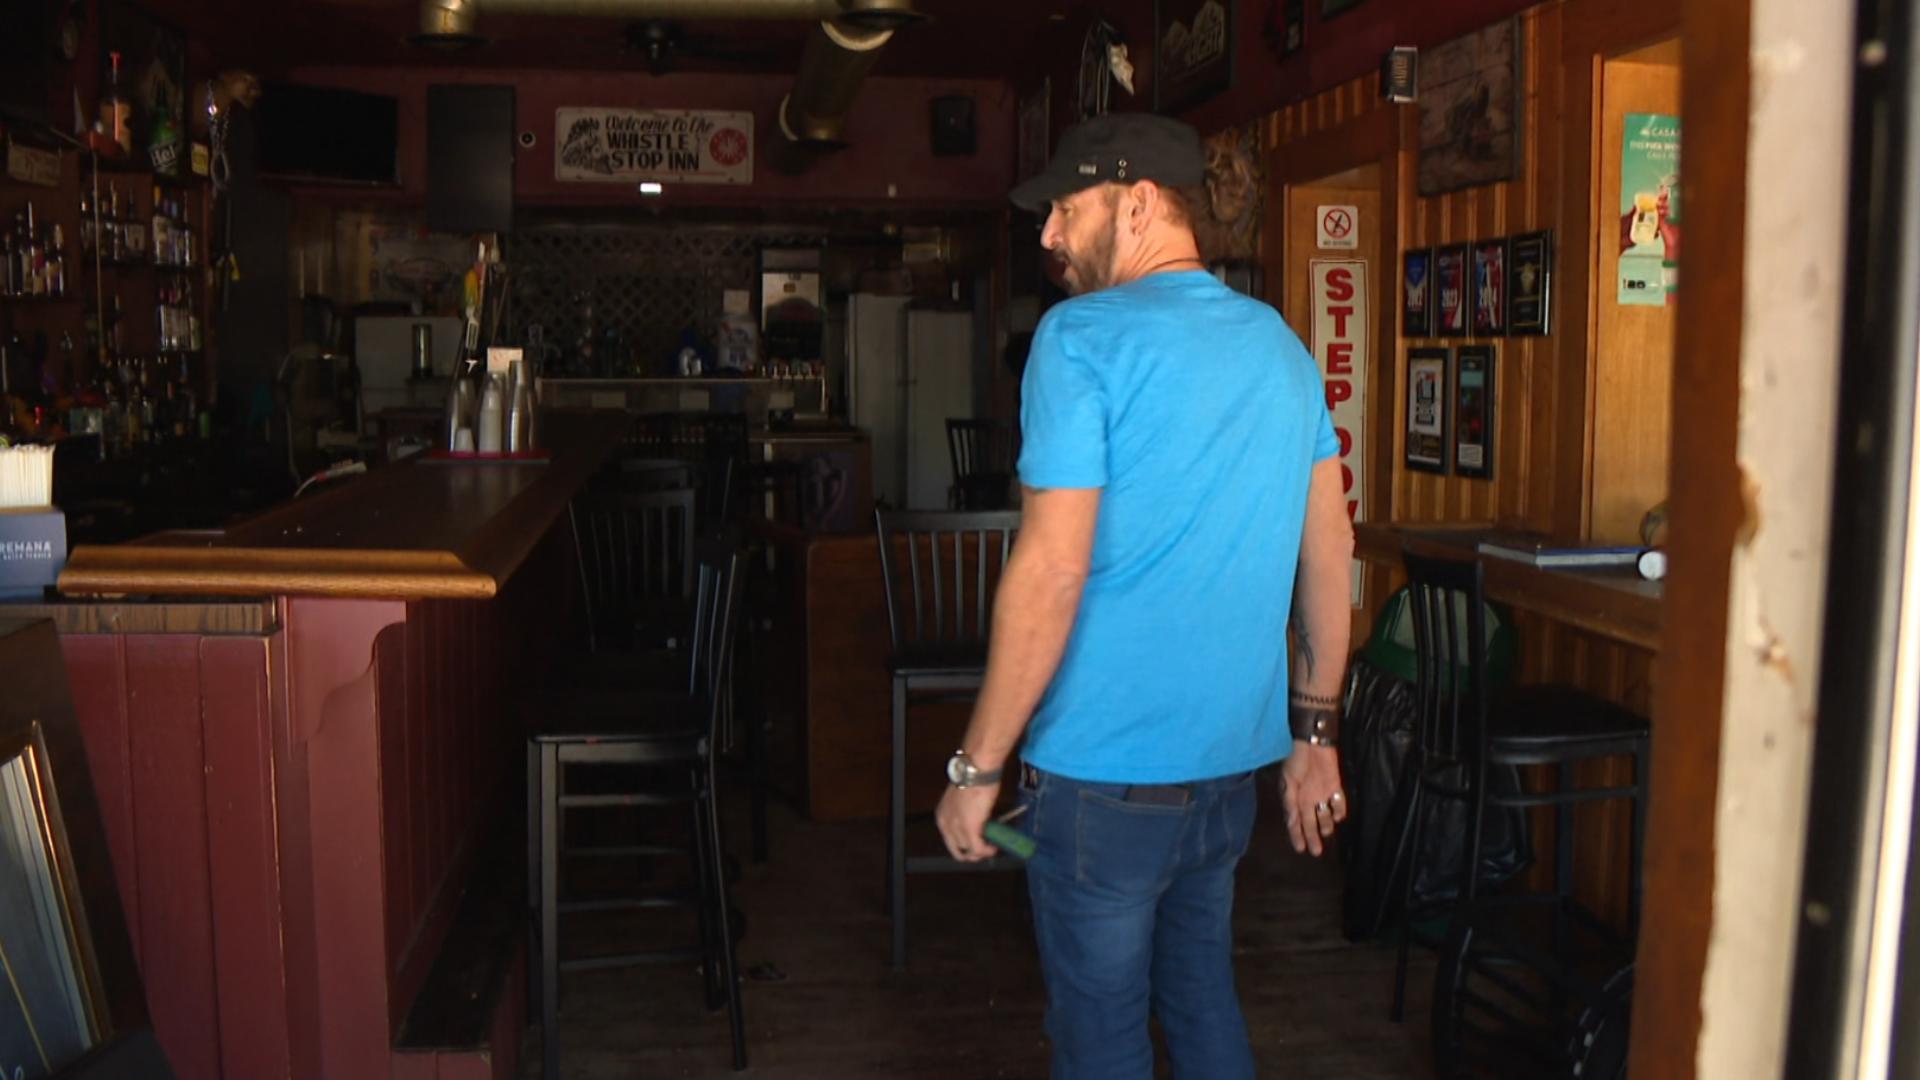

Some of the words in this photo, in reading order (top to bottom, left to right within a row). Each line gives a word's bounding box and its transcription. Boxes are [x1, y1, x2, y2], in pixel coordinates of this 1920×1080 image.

[605, 115, 669, 132] Welcome
[672, 116, 688, 132] to
[688, 117, 715, 133] the
[607, 132, 688, 150] WHISTLE
[611, 150, 663, 170] STOP
[668, 151, 699, 171] INN
[1325, 268, 1354, 411] STEP
